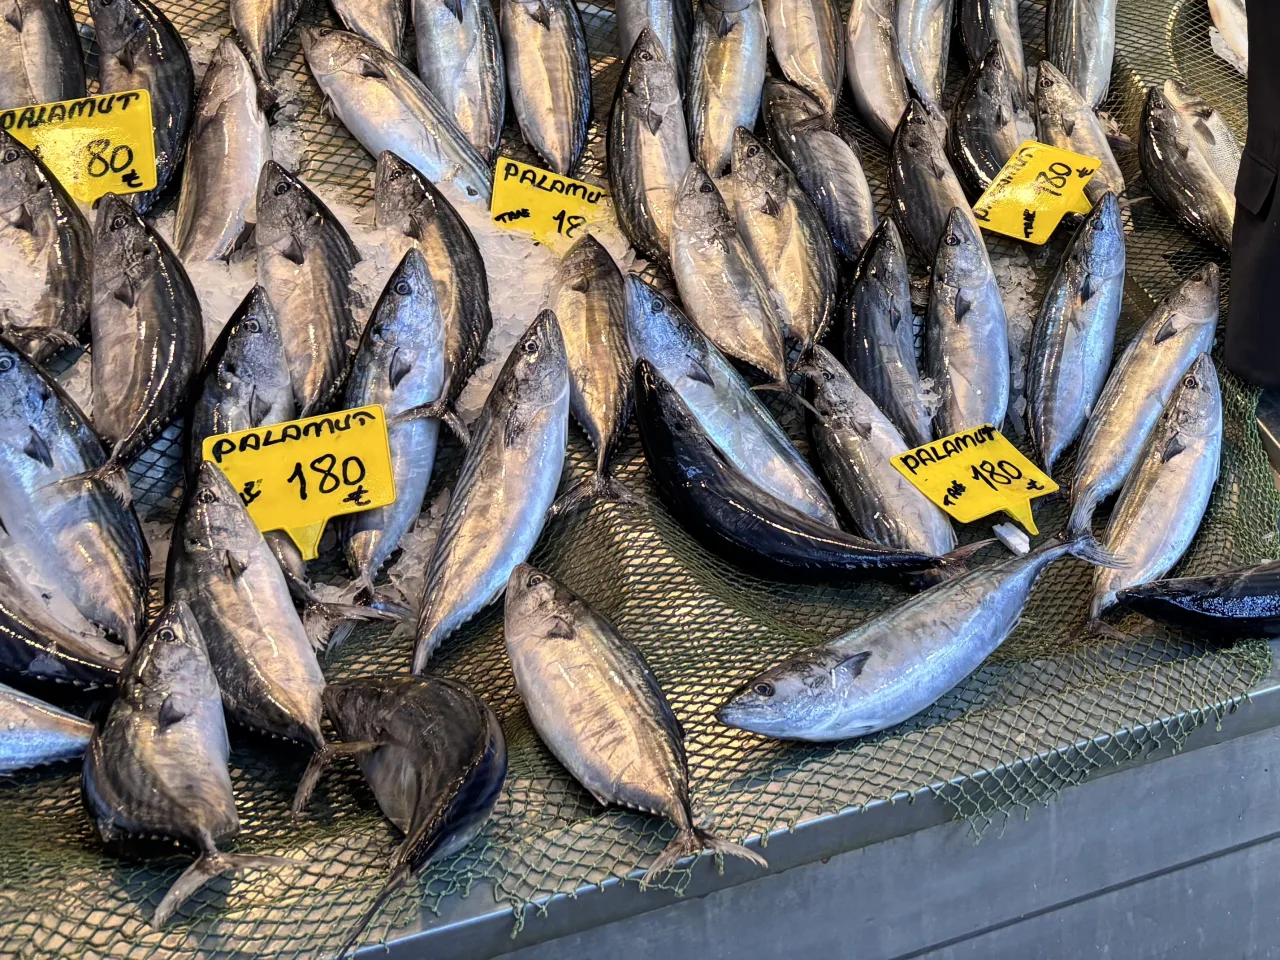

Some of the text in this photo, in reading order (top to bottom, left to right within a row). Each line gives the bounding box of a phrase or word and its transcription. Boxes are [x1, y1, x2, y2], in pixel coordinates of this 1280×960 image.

[211, 410, 377, 464] PALAMUT
[899, 424, 997, 476] PALAMUT
[287, 452, 367, 501] 180
[971, 459, 1023, 492] 180
